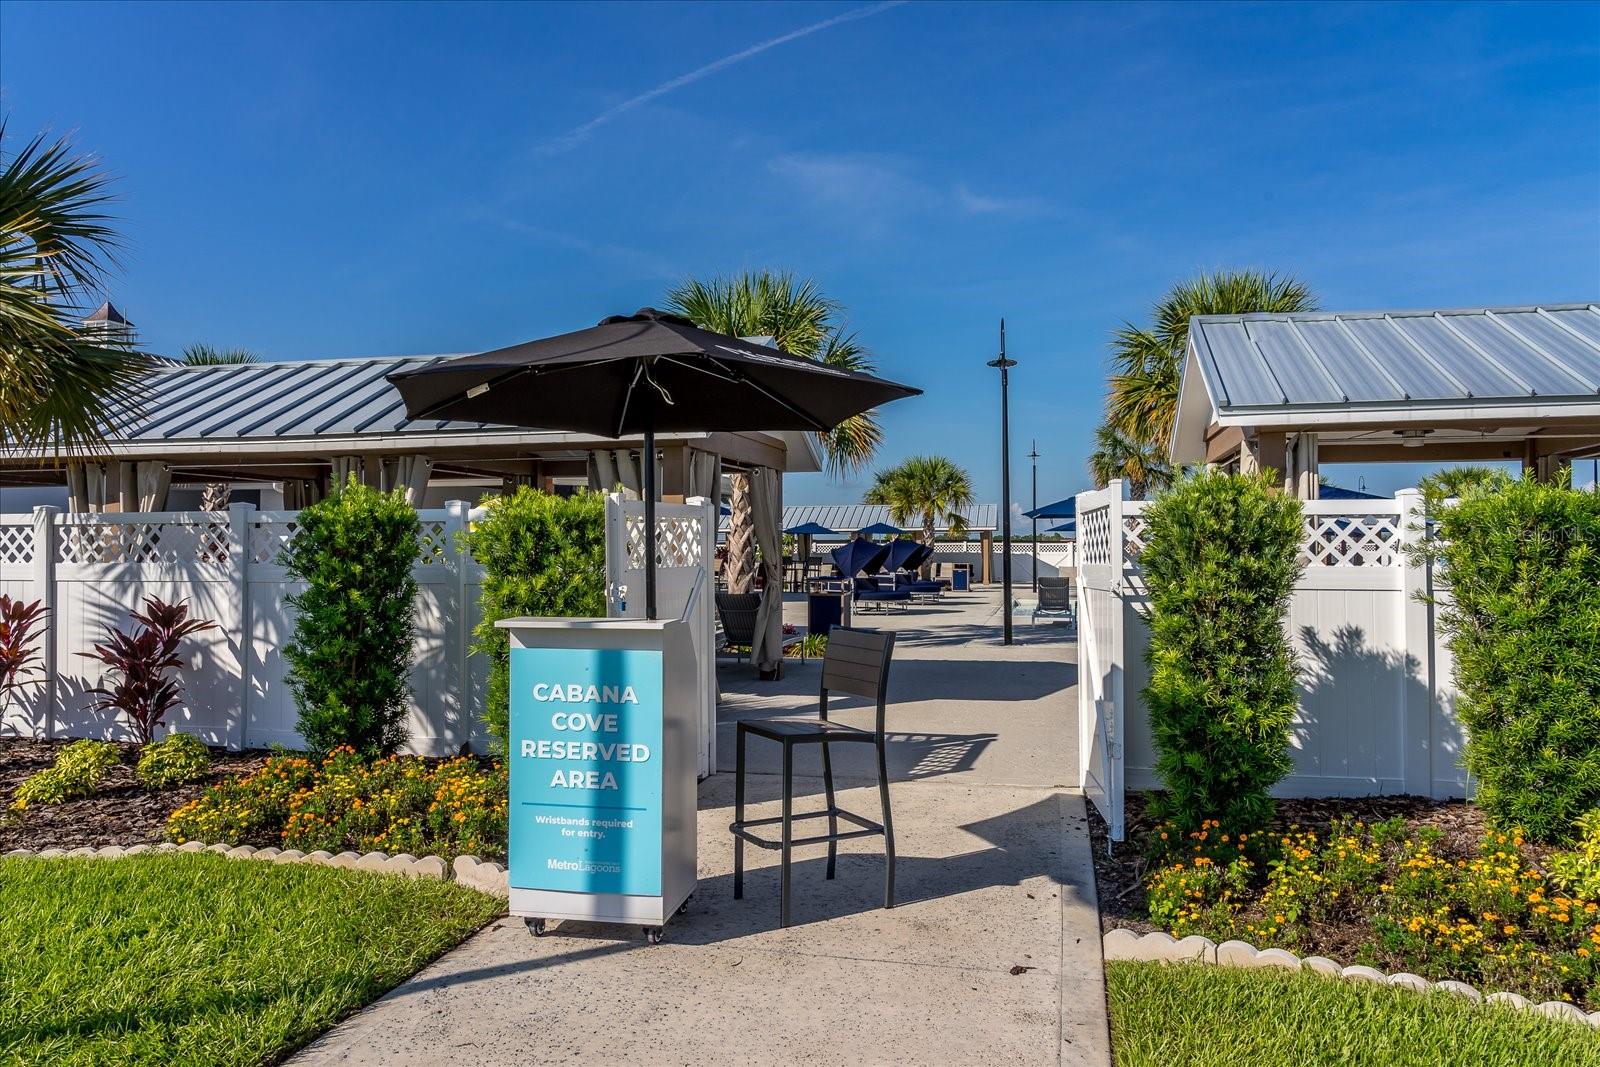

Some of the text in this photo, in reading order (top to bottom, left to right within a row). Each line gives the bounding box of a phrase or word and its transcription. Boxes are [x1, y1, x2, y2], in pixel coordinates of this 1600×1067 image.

[533, 683, 639, 704] CABANA
[551, 712, 618, 733] COVE
[521, 739, 650, 763] RESERVED
[550, 769, 619, 790] AREA
[535, 815, 633, 829] Wristbands required
[561, 827, 606, 840] for entry.
[547, 858, 621, 874] MetroLagoons
